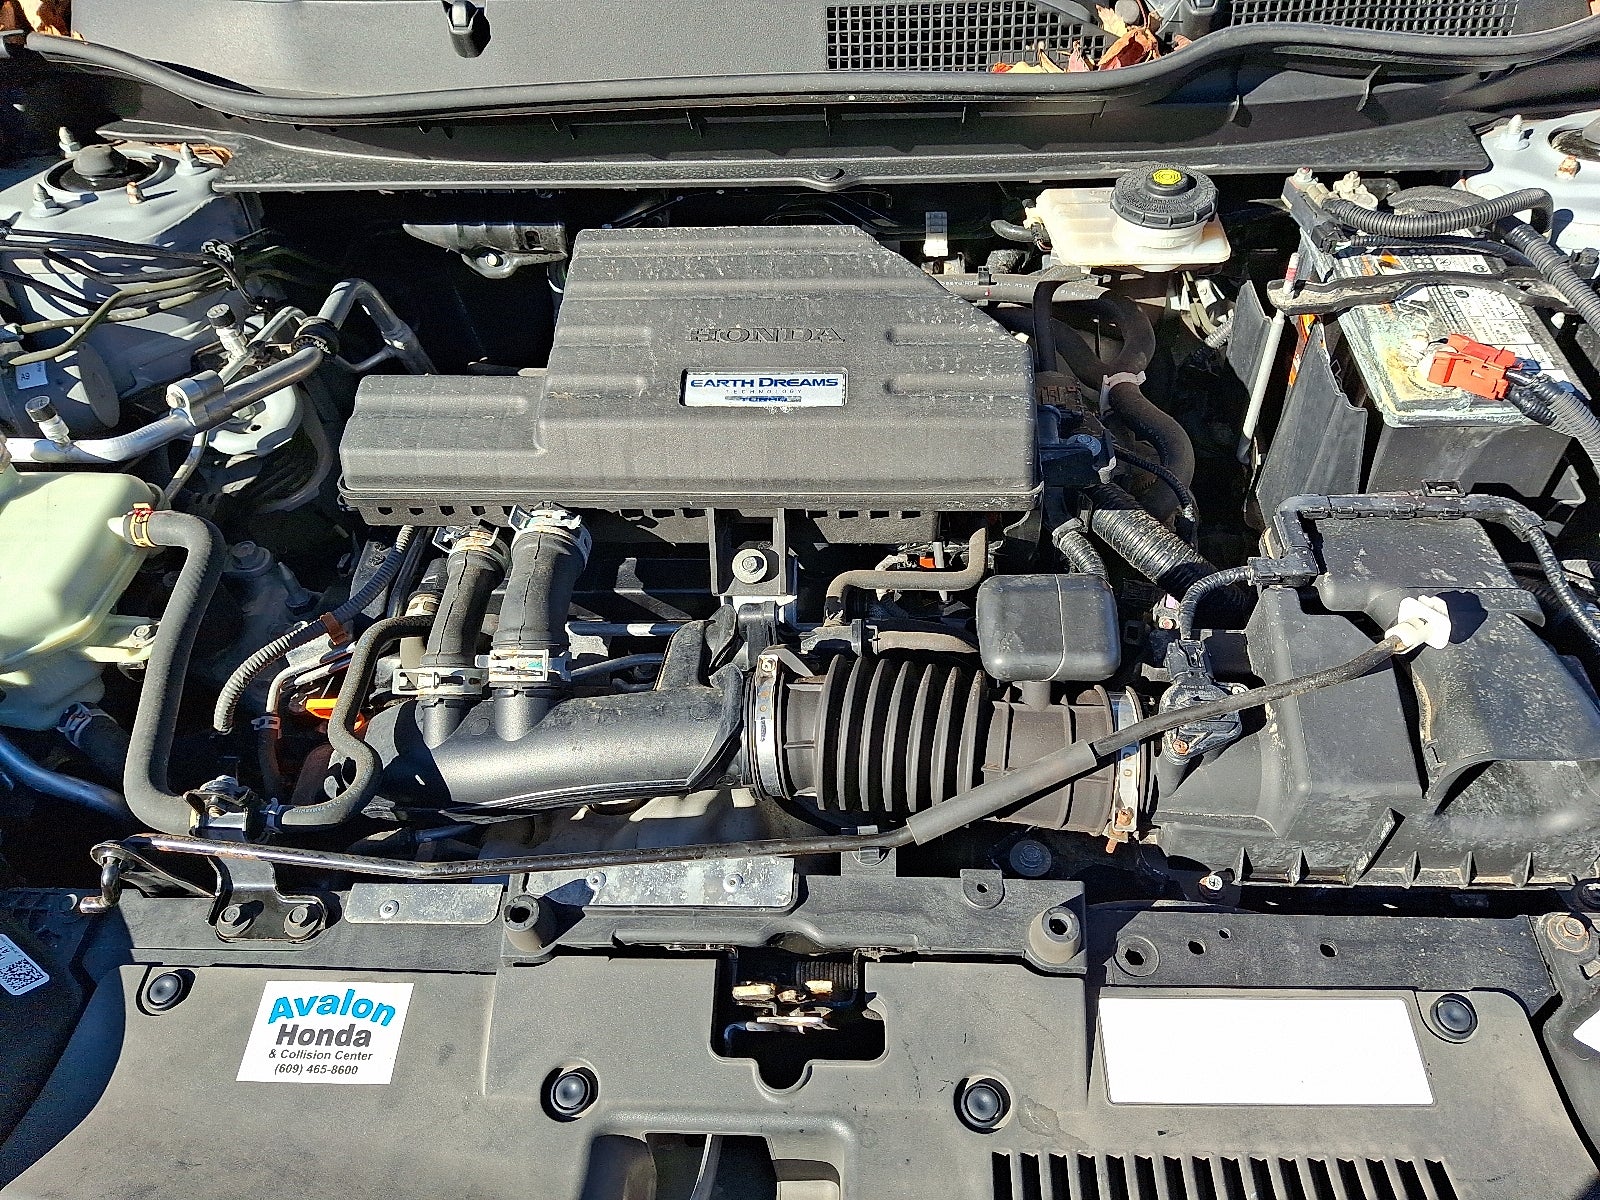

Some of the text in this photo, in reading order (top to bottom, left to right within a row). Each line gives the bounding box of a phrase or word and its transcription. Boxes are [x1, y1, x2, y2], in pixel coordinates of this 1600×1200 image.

[685, 327, 846, 343] HONDA
[690, 377, 839, 388] EARTH DREAMS
[268, 988, 396, 1027] Avalon
[275, 1023, 372, 1048] Honda
[268, 1049, 374, 1061] & Collision Center
[274, 1063, 359, 1076] (609) 465-8600
